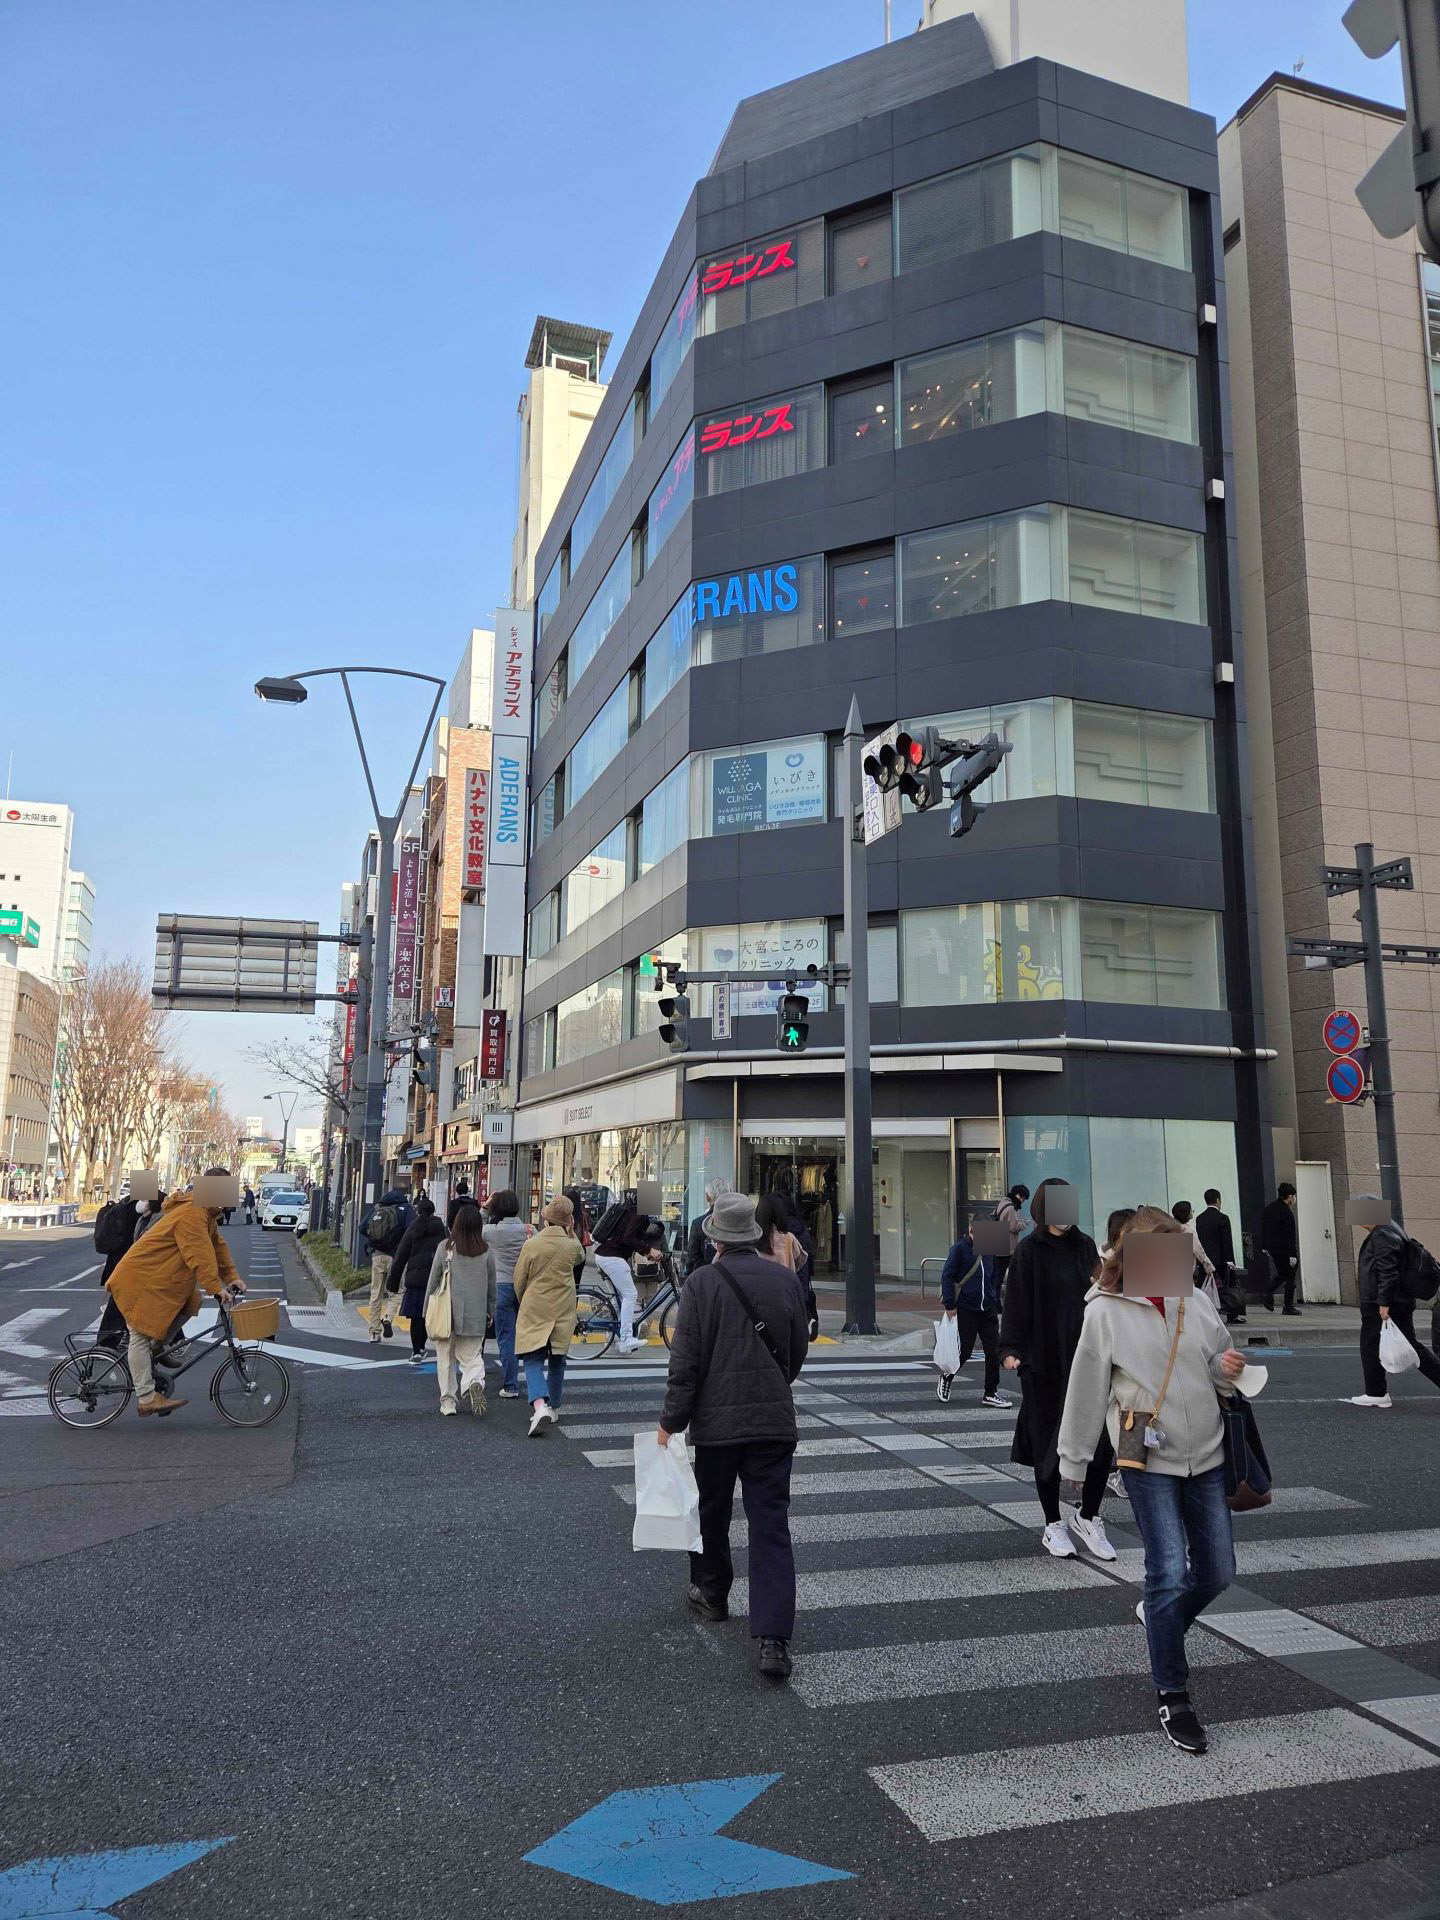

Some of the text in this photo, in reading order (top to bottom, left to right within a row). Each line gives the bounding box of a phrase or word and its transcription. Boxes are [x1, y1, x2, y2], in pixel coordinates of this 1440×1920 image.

[503, 651, 523, 717] アデランス
[773, 769, 816, 786] いびき
[717, 786, 736, 796] WILL
[726, 793, 753, 804] CLINIC
[496, 756, 520, 843] ADERANS
[22, 813, 57, 823] 太陽生命
[466, 772, 487, 885] ハナヤ文化教室
[402, 842, 420, 854] 5F
[739, 939, 819, 955] 大宮こころの
[396, 947, 413, 993] 楽座や
[740, 956, 795, 972] クリニック
[488, 1029, 498, 1075] 買取専門店
